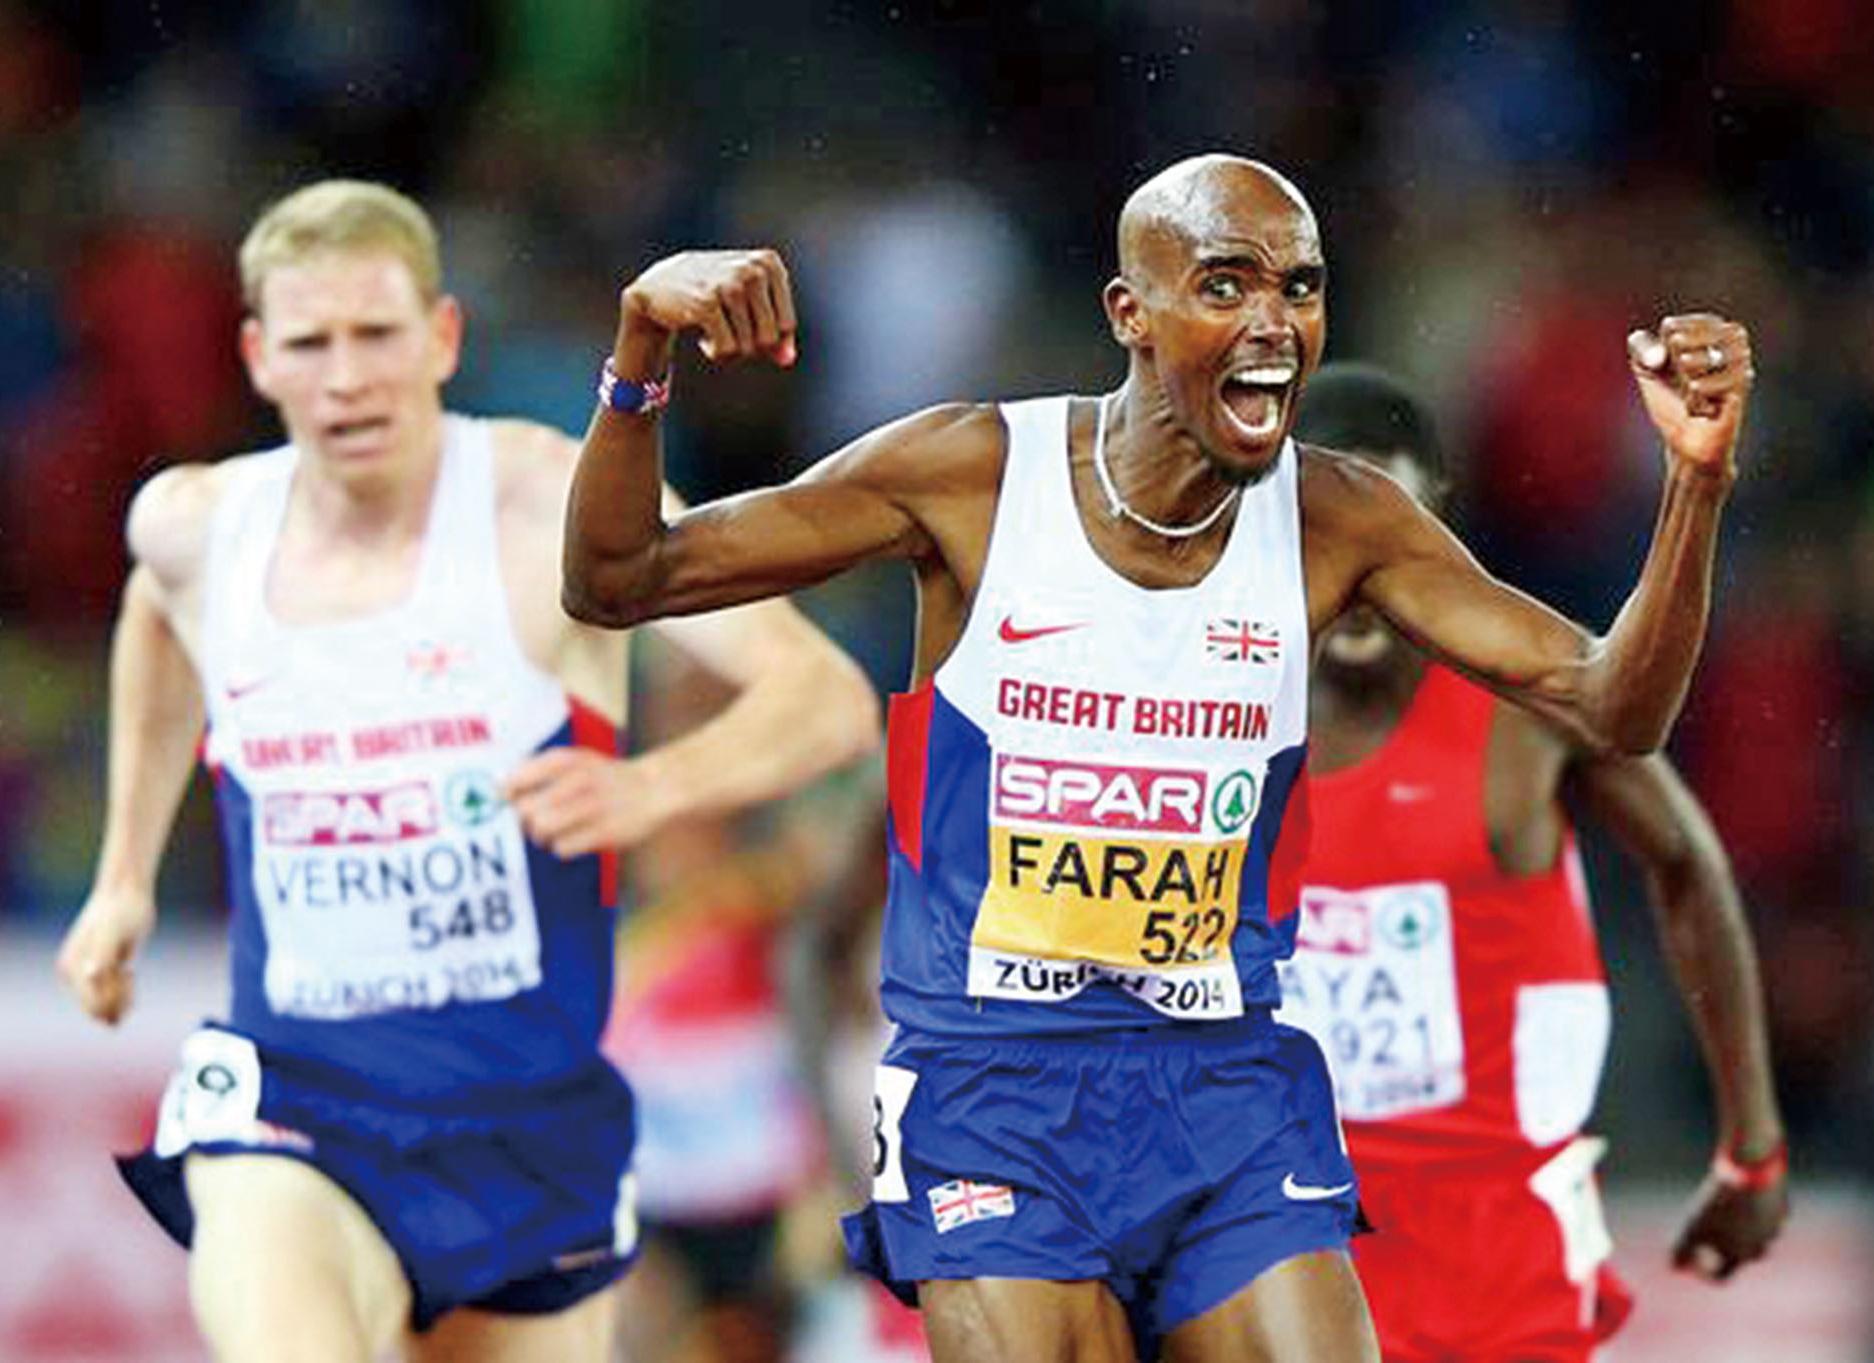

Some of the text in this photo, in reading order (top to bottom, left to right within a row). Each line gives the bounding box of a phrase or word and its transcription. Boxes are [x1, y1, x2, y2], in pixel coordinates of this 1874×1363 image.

[998, 678, 1273, 742] GREAT BRITAIN
[266, 784, 434, 843] SPAR
[998, 764, 1201, 826] SPAR
[268, 836, 508, 906] VERNON
[1009, 835, 1229, 904] FARAH
[410, 889, 515, 951] 548
[1140, 907, 1228, 965] 522
[1156, 979, 1225, 1012] 2014
